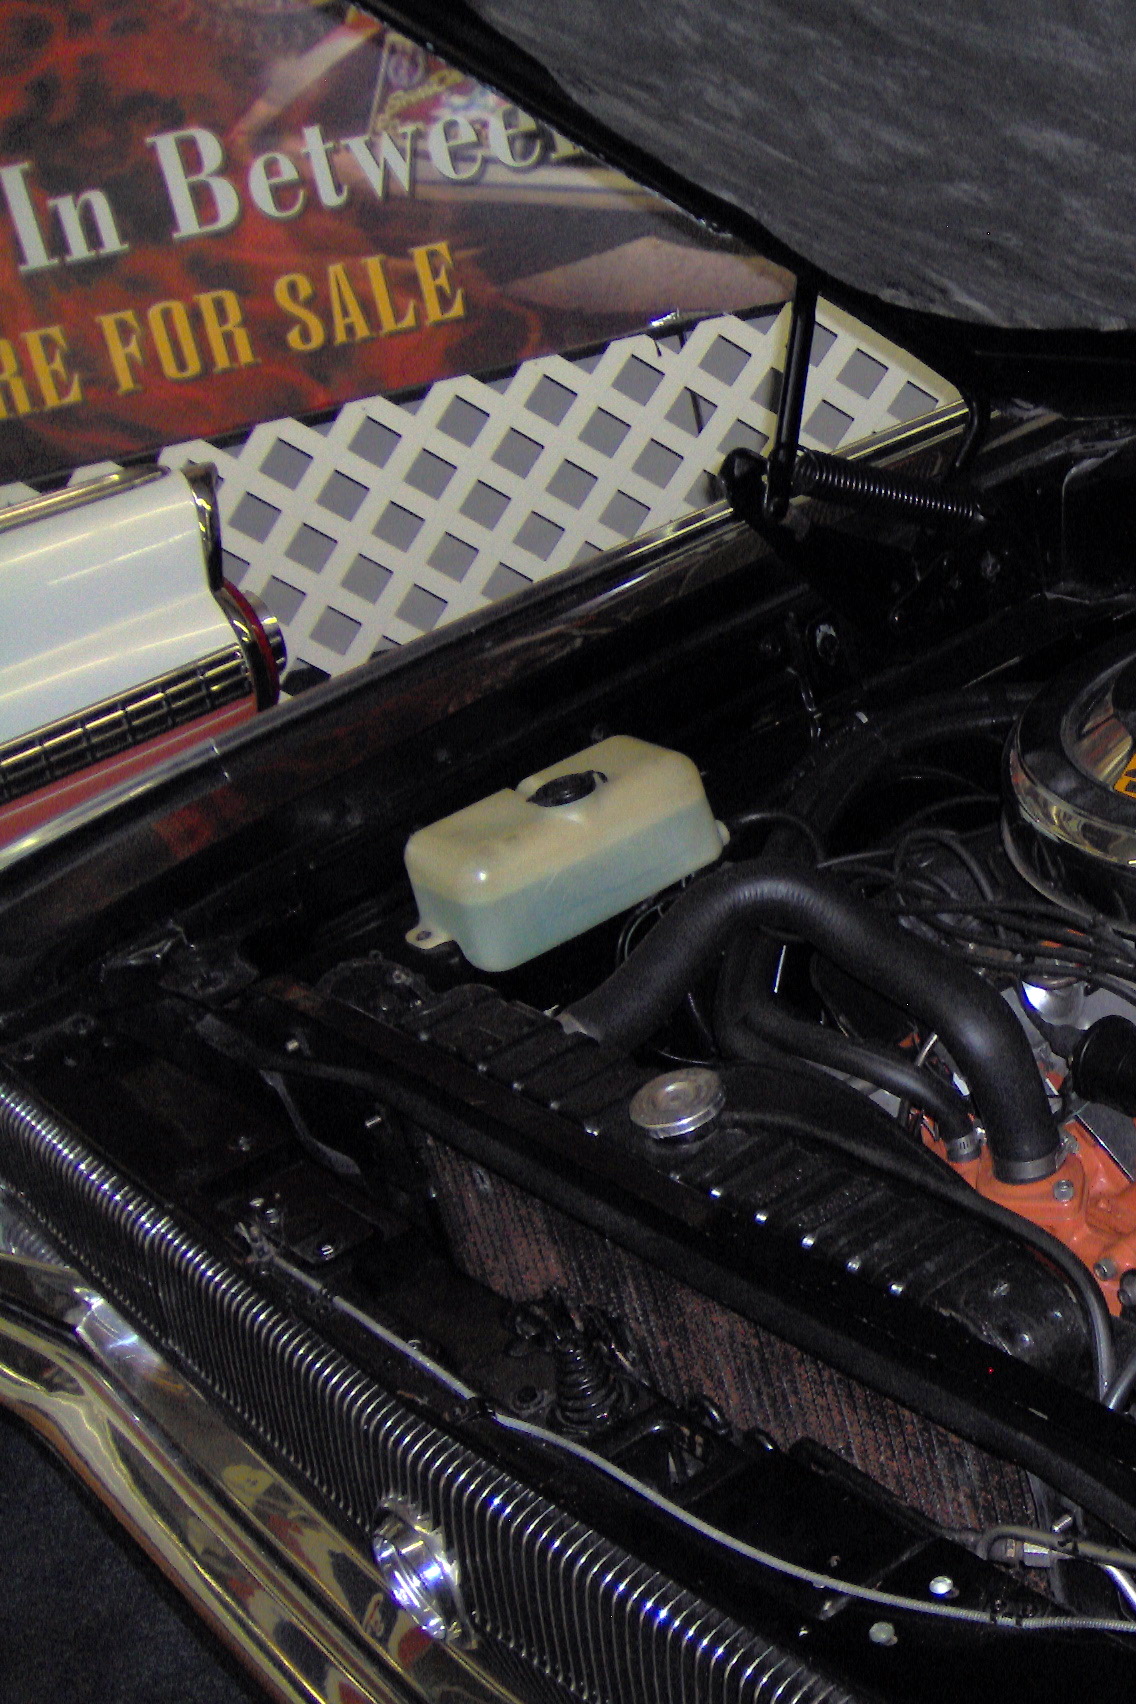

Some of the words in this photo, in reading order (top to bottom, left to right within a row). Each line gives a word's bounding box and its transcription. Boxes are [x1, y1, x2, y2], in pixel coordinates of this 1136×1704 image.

[0, 161, 129, 274] In
[146, 103, 584, 240] Betwee
[95, 288, 259, 395] FOR
[272, 241, 465, 353] SALE
